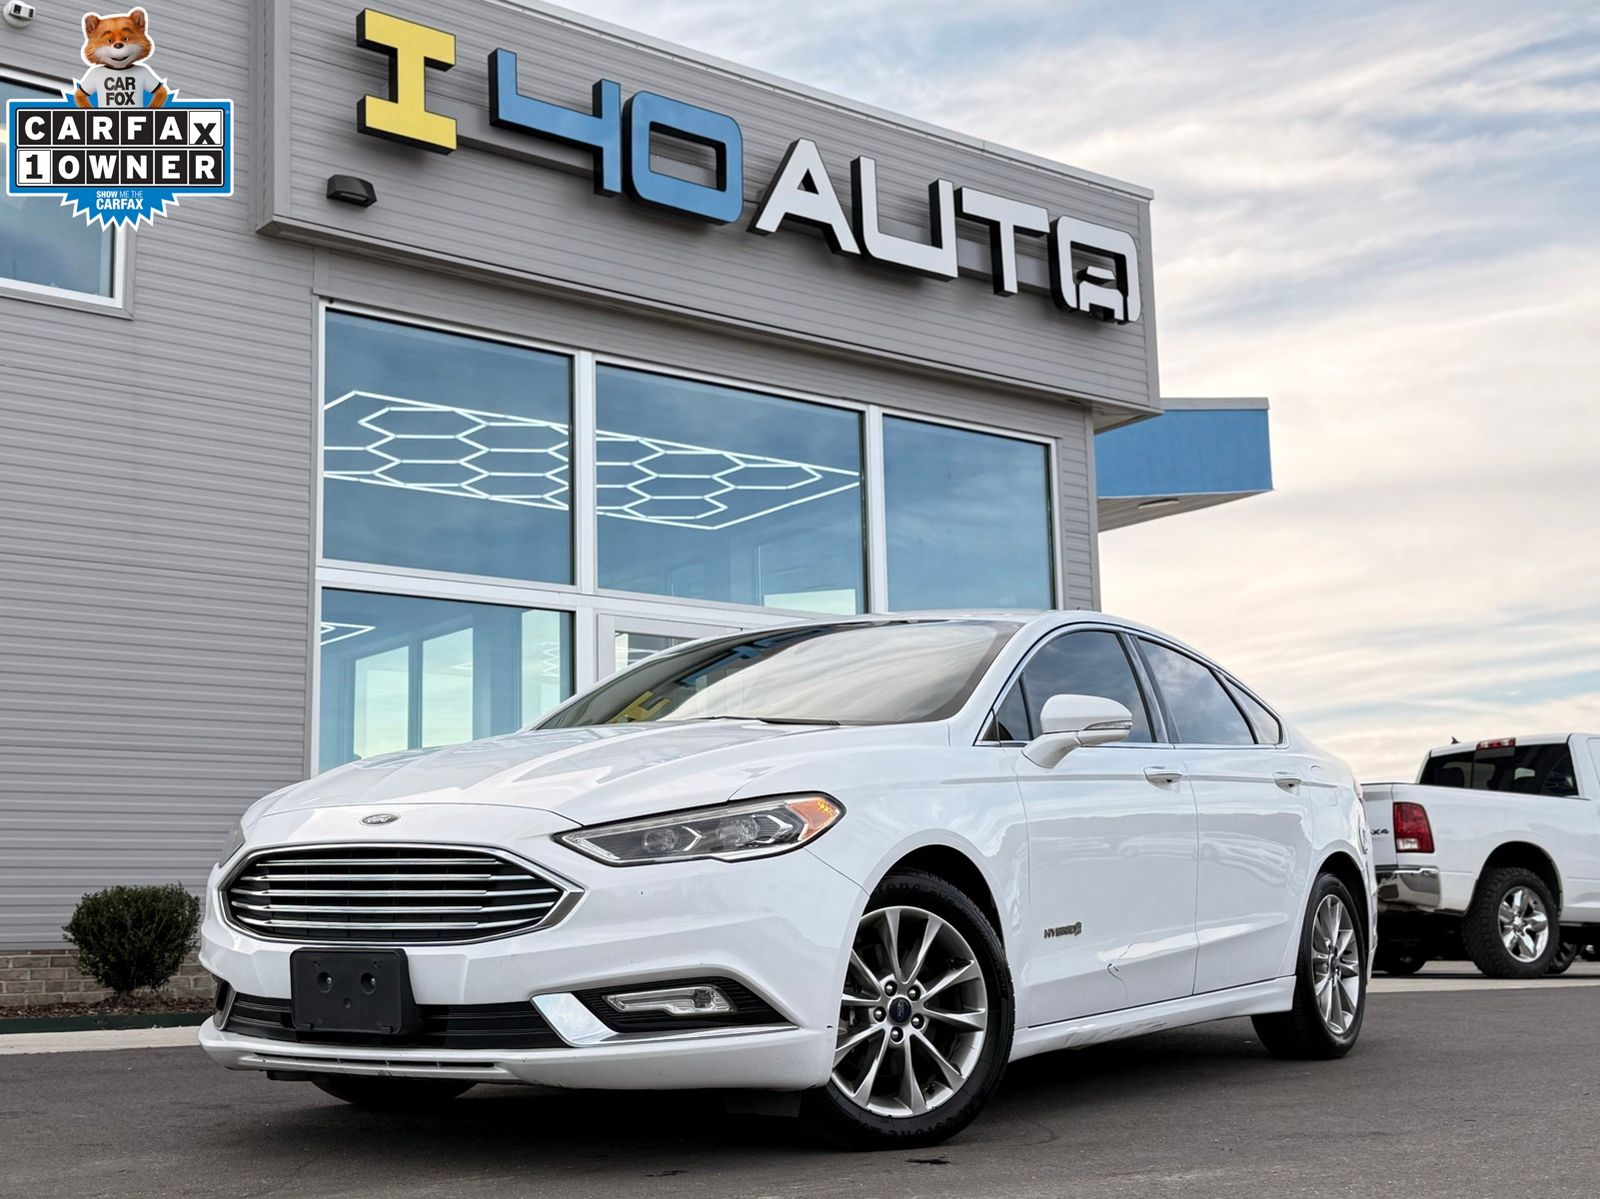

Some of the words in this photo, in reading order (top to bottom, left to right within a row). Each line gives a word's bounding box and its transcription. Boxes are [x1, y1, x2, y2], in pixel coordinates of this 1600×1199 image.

[357, 8, 457, 154] I
[488, 47, 743, 224] 40
[747, 137, 1142, 325] AUTO
